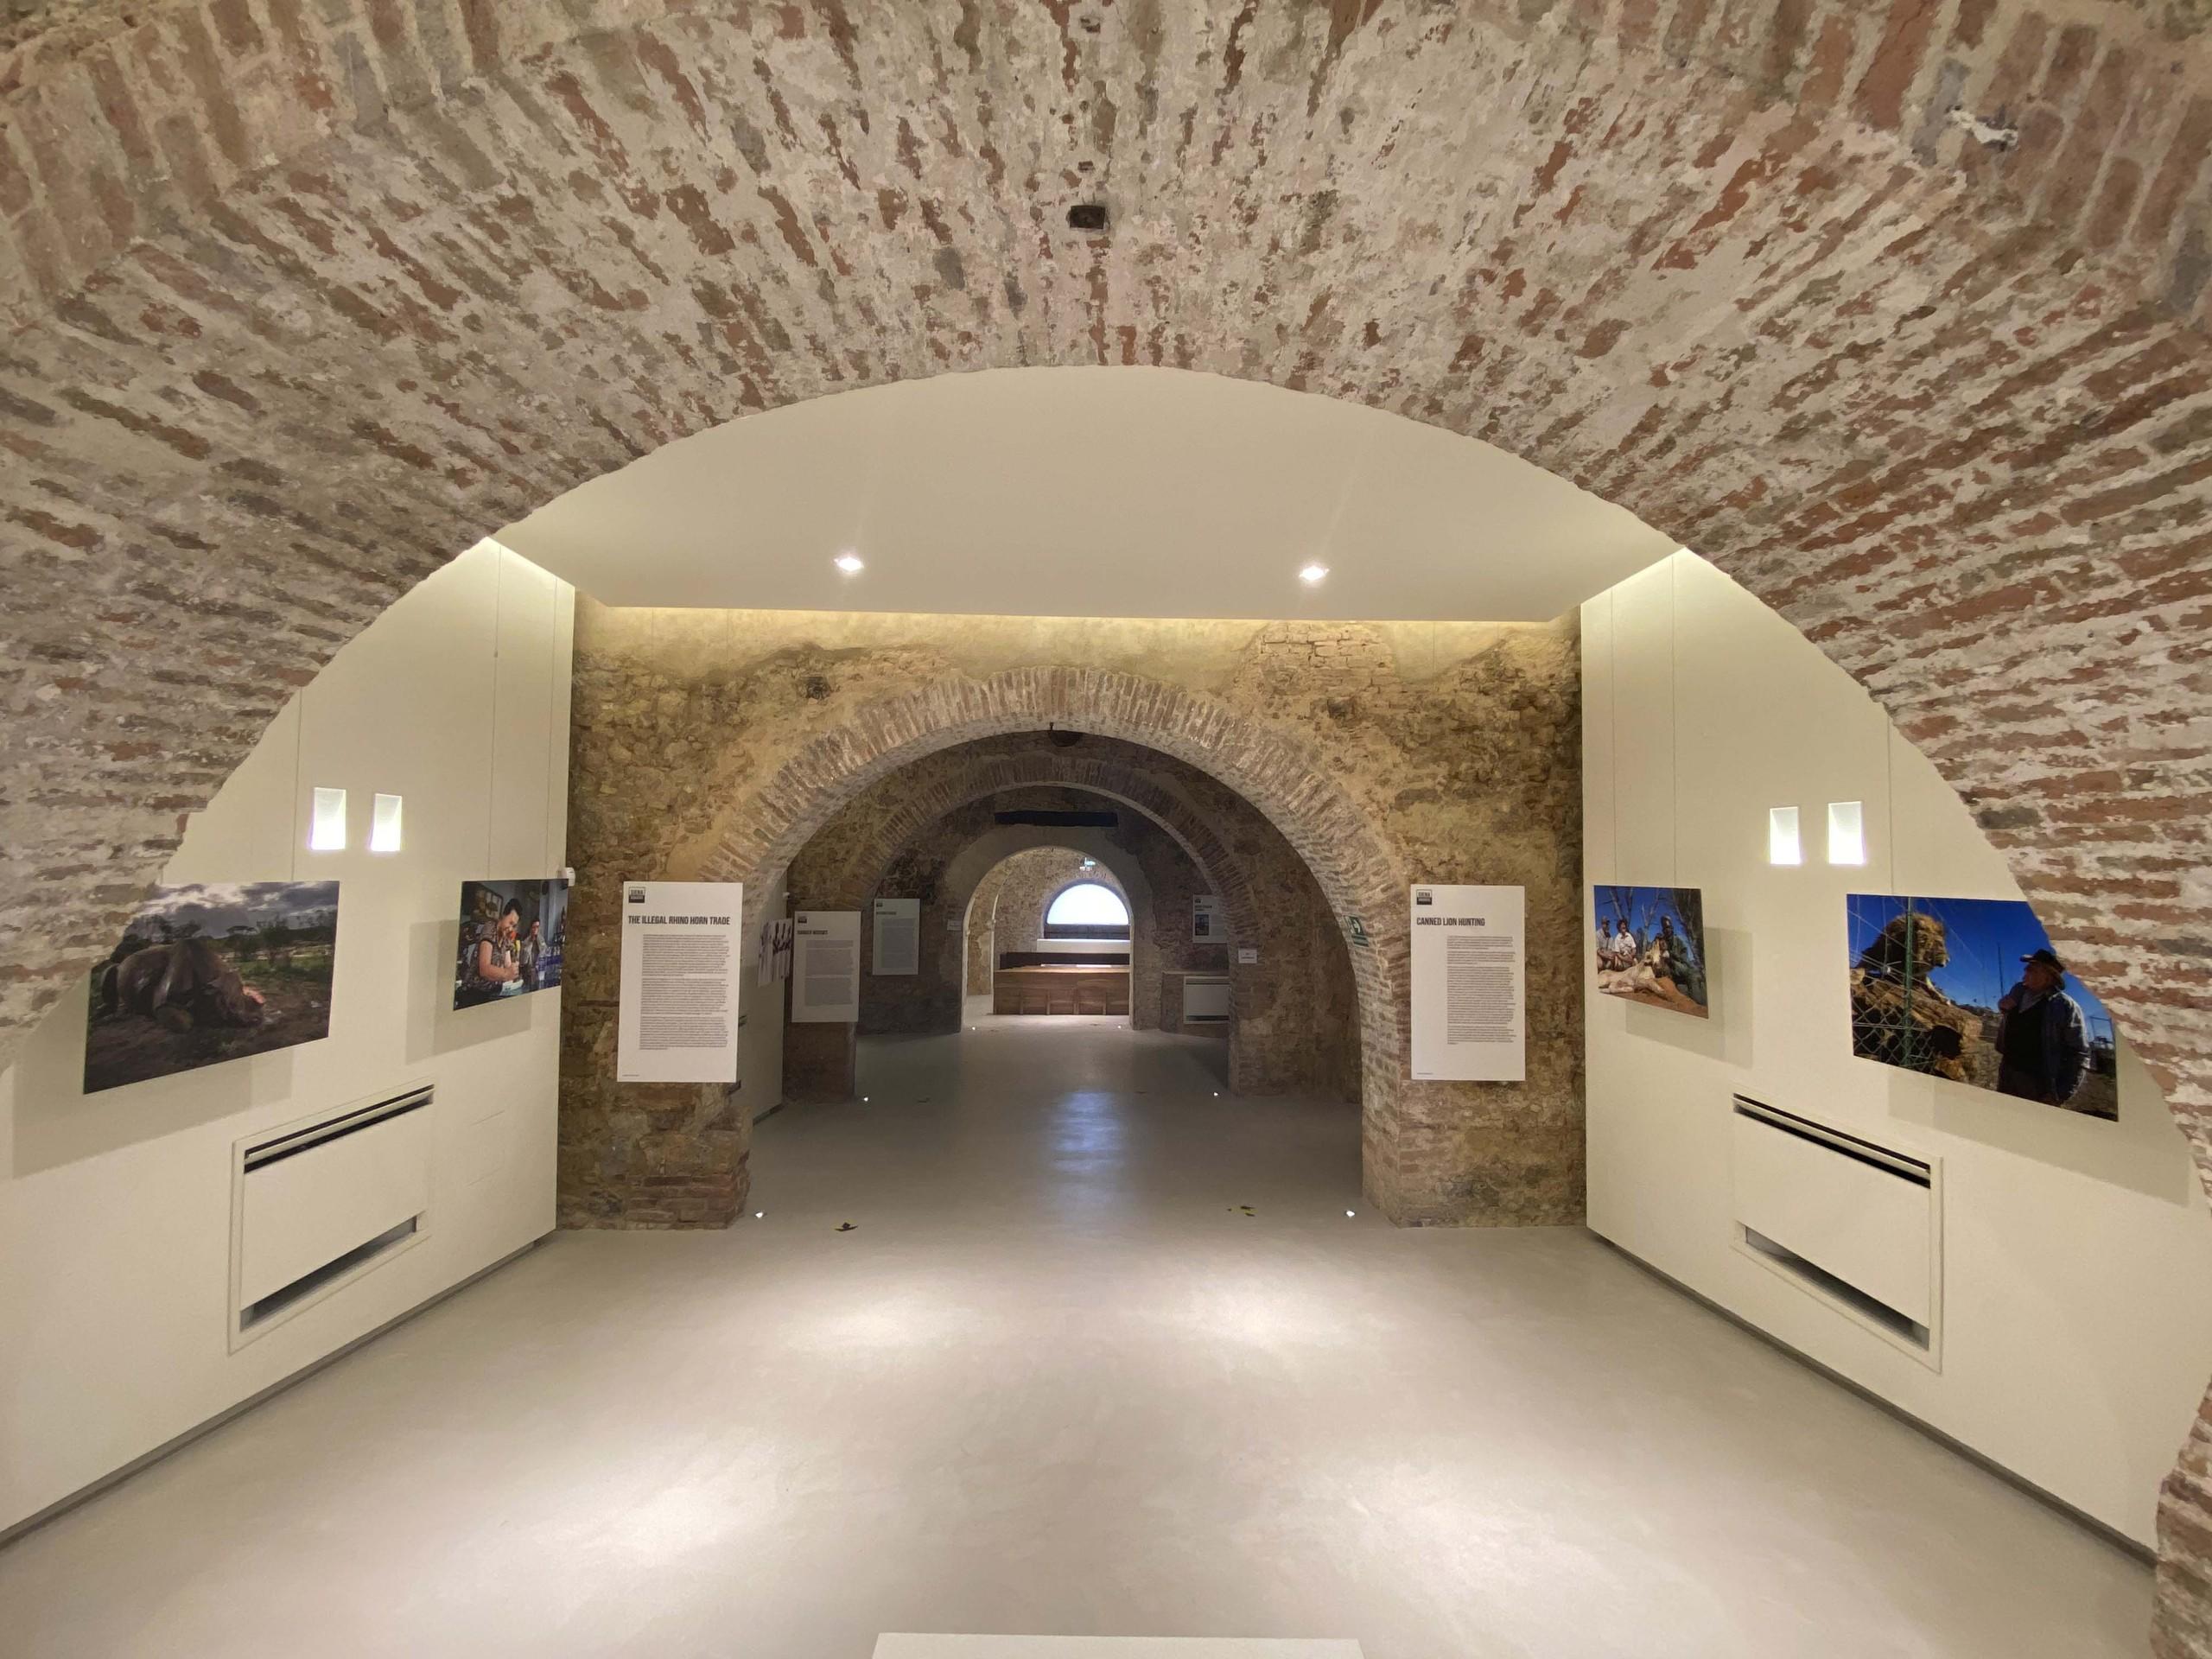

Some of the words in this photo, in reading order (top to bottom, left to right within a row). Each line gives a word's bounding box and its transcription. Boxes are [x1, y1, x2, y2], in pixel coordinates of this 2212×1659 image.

[628, 915, 640, 925] THE
[642, 916, 667, 925] ILLEGAL
[669, 916, 689, 925] RHINO
[709, 917, 730, 925] TRADE
[1416, 917, 1442, 925] CANNED
[1443, 918, 1457, 926] LION
[1458, 918, 1485, 926] HUNTING
